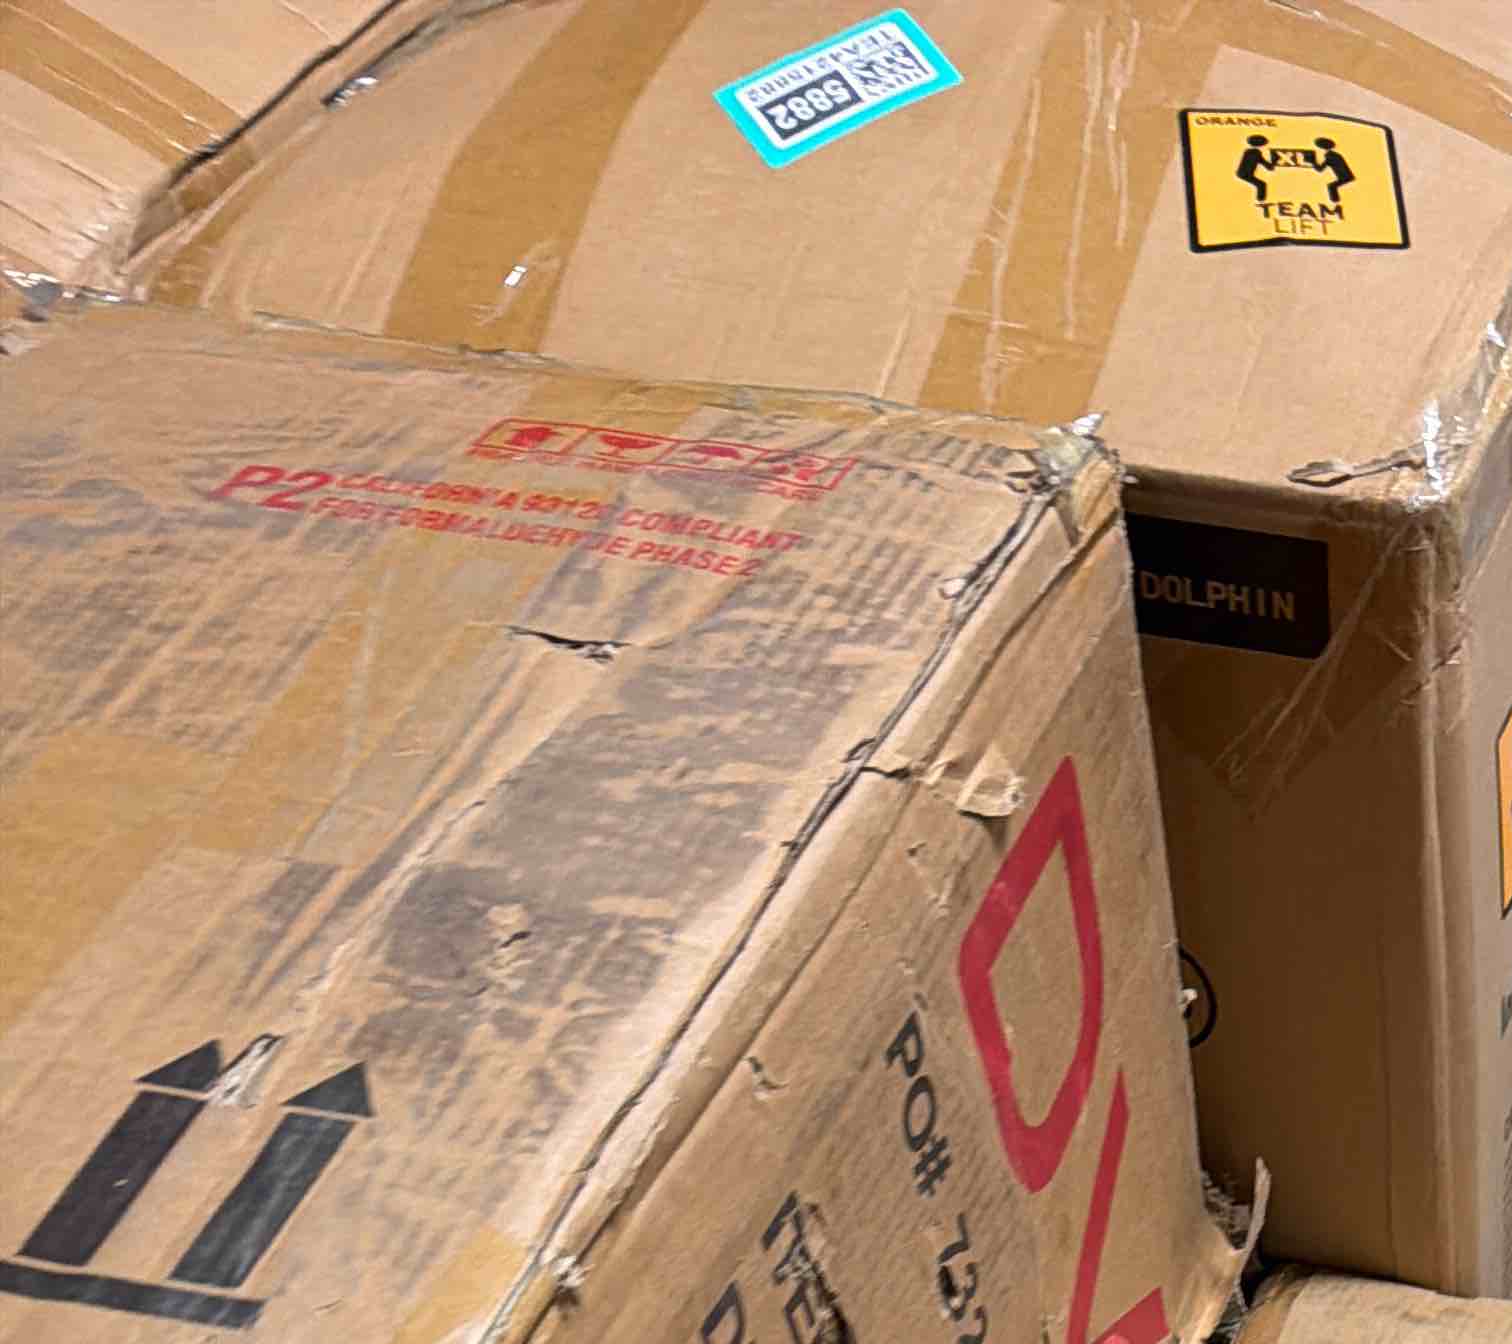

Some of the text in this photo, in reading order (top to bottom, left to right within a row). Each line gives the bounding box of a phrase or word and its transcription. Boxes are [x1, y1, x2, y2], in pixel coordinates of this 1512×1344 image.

[766, 79, 853, 131] 5882
[1195, 115, 1278, 128] ORANGE
[1276, 150, 1316, 168] XL
[1256, 201, 1344, 220] TEAM
[1274, 217, 1334, 235] LIFT
[205, 463, 335, 512] P2
[617, 507, 802, 552] COMPLIANT
[628, 541, 740, 577] PHASE
[1141, 569, 1295, 623] DOLPHIN
[883, 1010, 953, 1198] PO#
